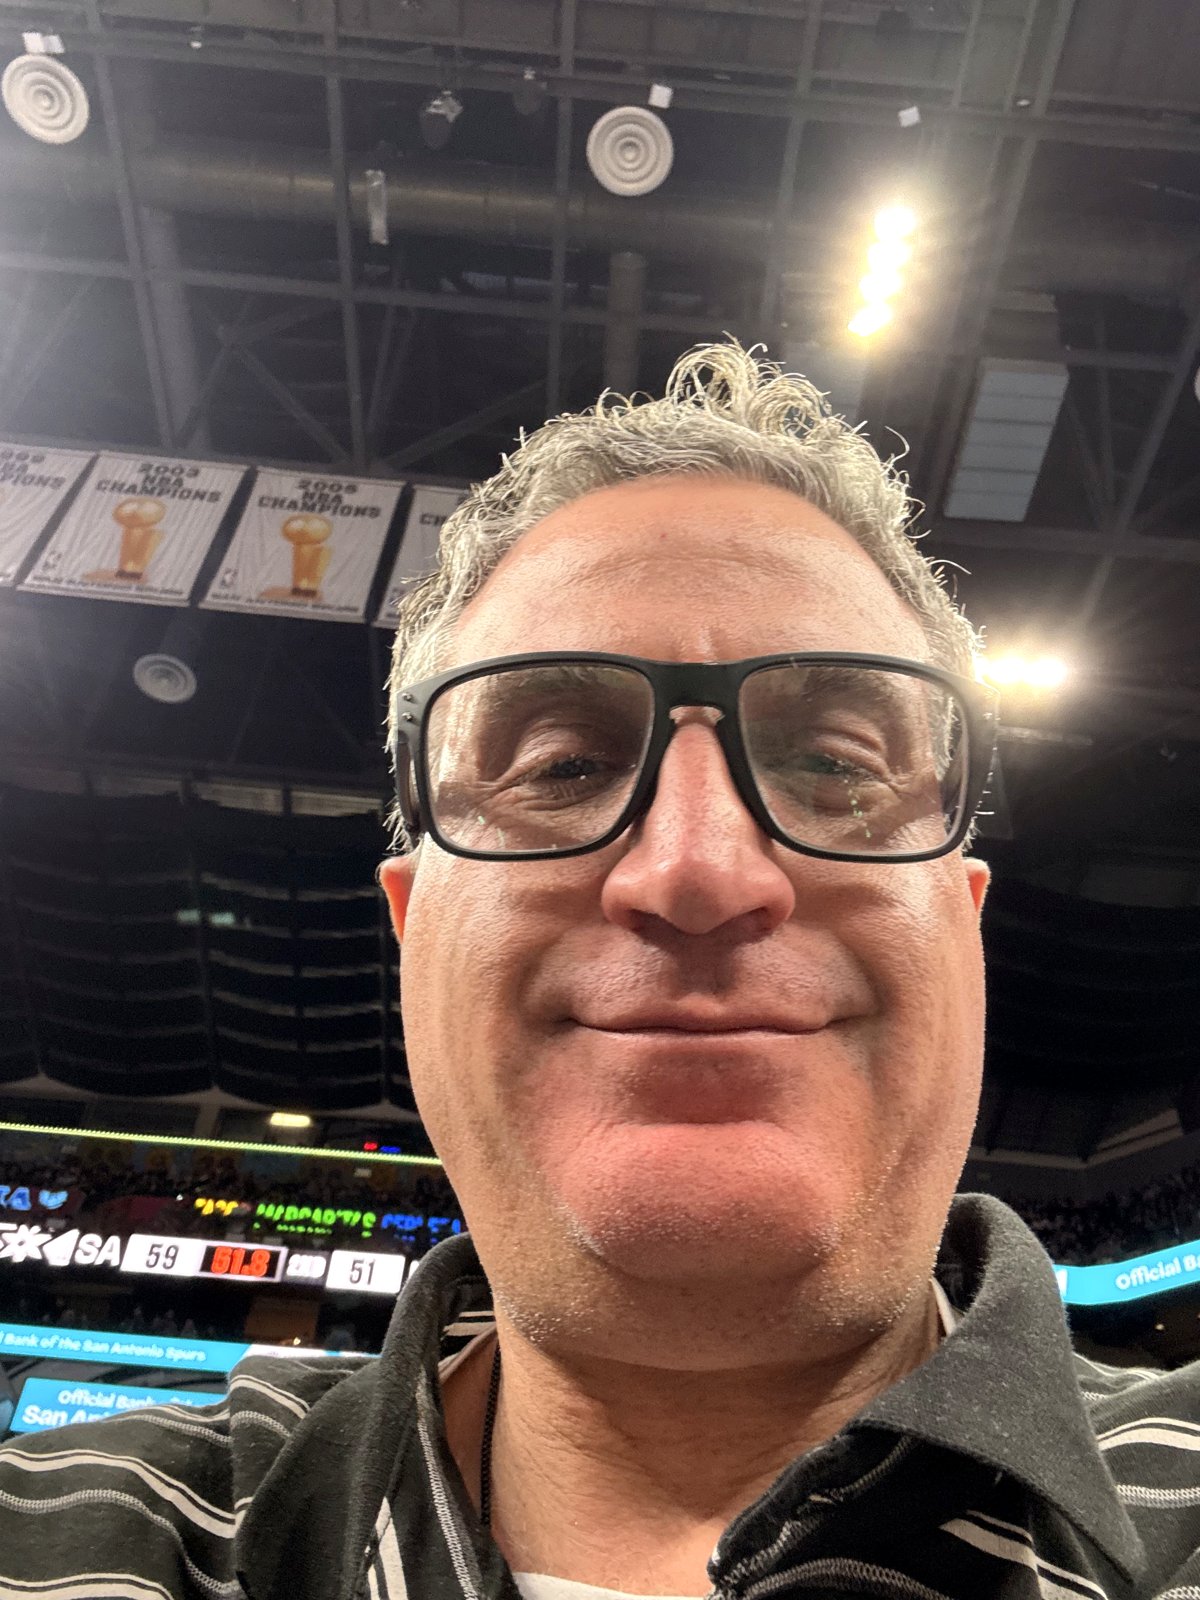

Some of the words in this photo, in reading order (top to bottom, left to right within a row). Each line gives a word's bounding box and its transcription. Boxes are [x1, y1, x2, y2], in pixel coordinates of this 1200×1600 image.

[96, 480, 221, 502] CHAMPIONS
[257, 496, 381, 519] CHAMPIONS
[75, 1233, 121, 1266] SA
[145, 1243, 179, 1270] 59
[350, 1258, 376, 1286] 51
[1115, 1256, 1182, 1290] Official
[58, 1387, 116, 1409] Official
[22, 1404, 68, 1426] San
